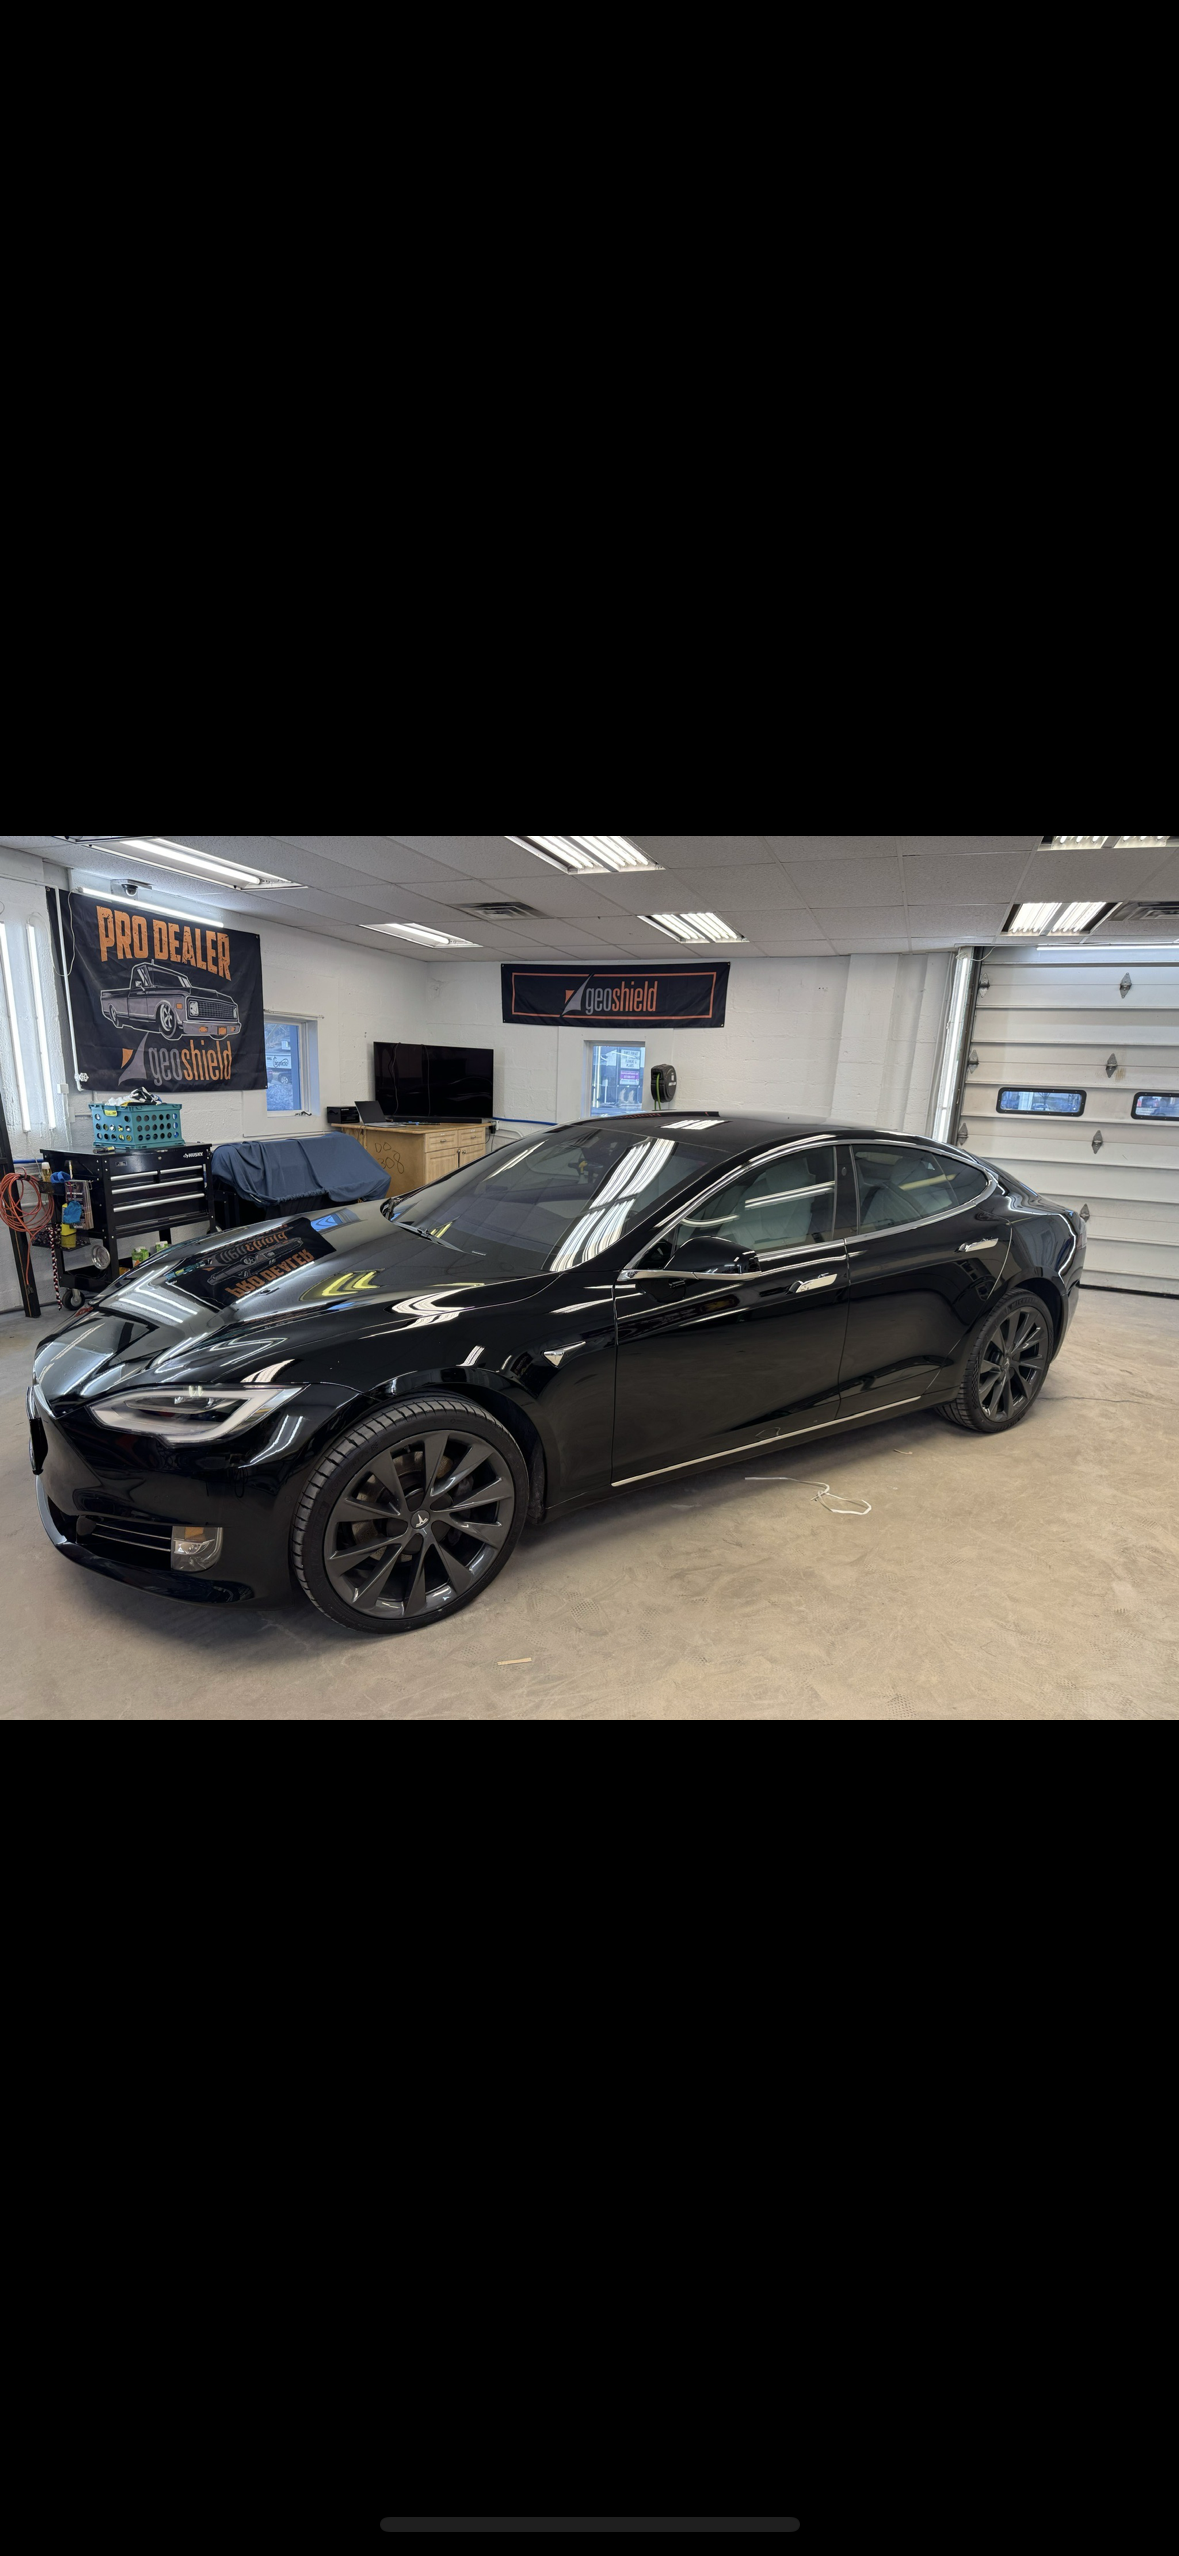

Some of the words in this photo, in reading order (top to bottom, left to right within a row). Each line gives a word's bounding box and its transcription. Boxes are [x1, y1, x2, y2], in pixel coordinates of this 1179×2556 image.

[96, 905, 149, 962] PRO
[152, 919, 232, 981] DEALER
[585, 981, 658, 1015] geoshield
[148, 1039, 232, 1086] geoshield
